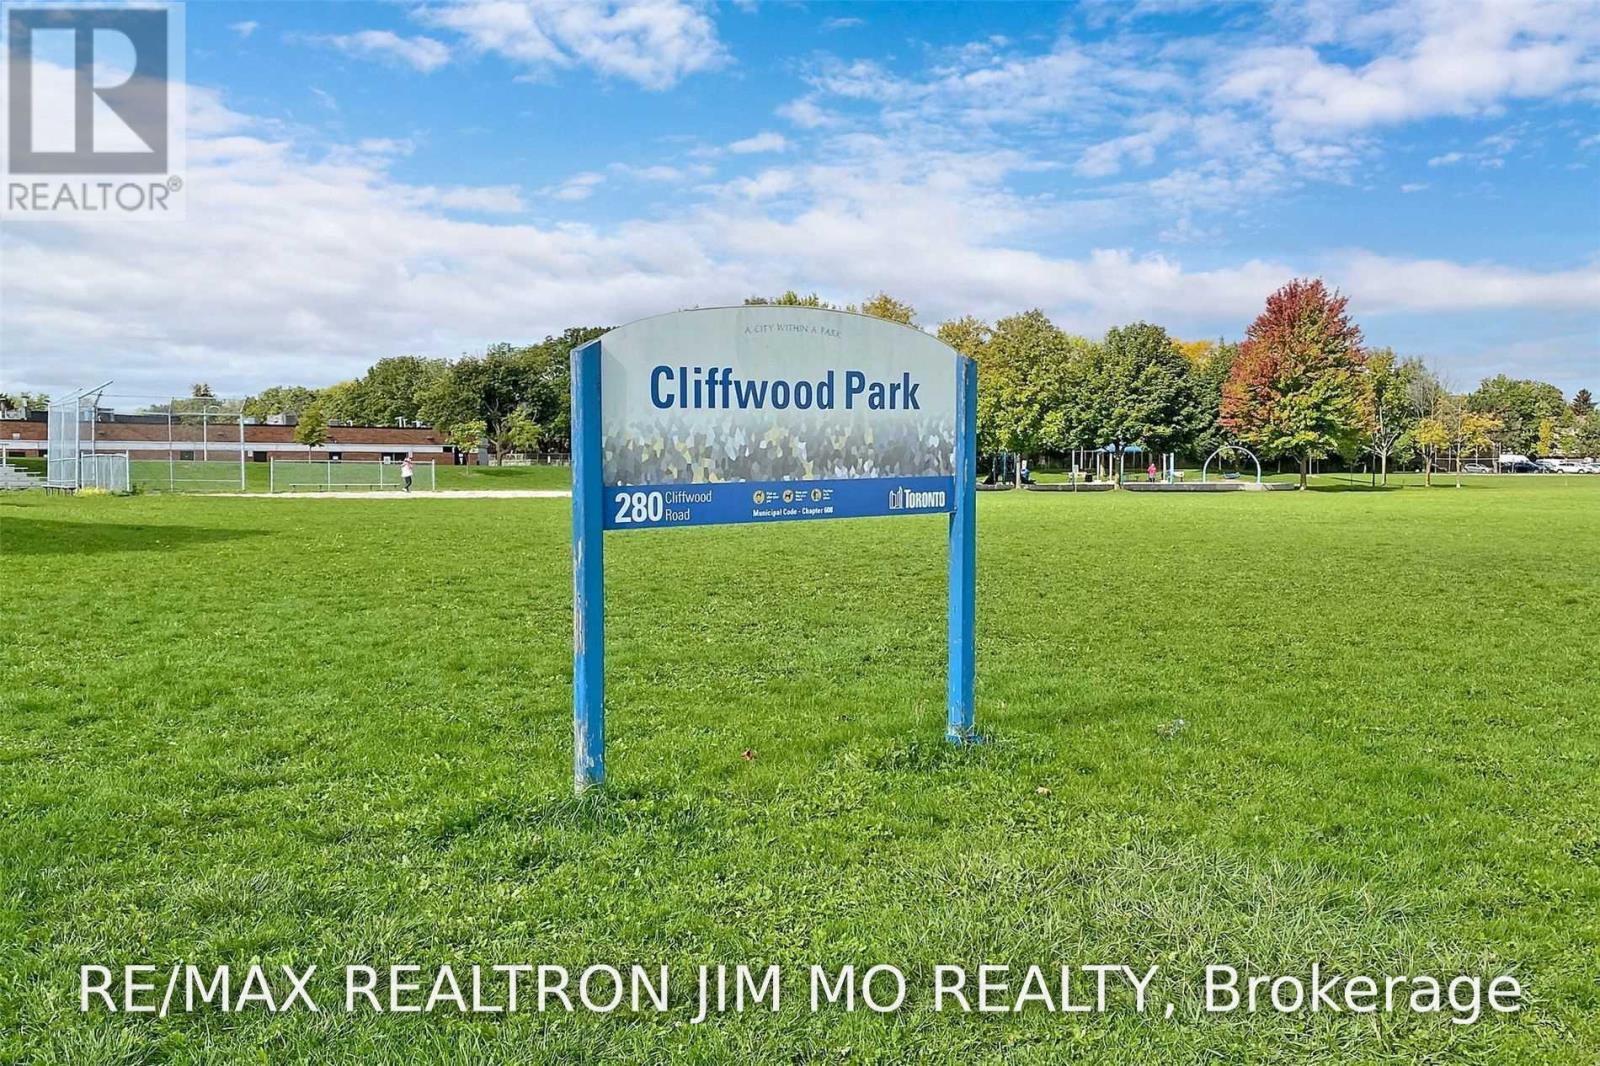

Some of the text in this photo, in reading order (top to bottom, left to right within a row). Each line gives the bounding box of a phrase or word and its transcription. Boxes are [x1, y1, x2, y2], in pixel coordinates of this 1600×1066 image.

[754, 324, 775, 334] CITY
[776, 322, 809, 333] WITHIN
[650, 364, 921, 410] Cliffwood Park
[665, 490, 712, 504] Cliffwood
[615, 491, 663, 523] 280
[752, 508, 782, 517] Municipal
[802, 507, 823, 516] Chapter
[665, 509, 690, 521] Road
